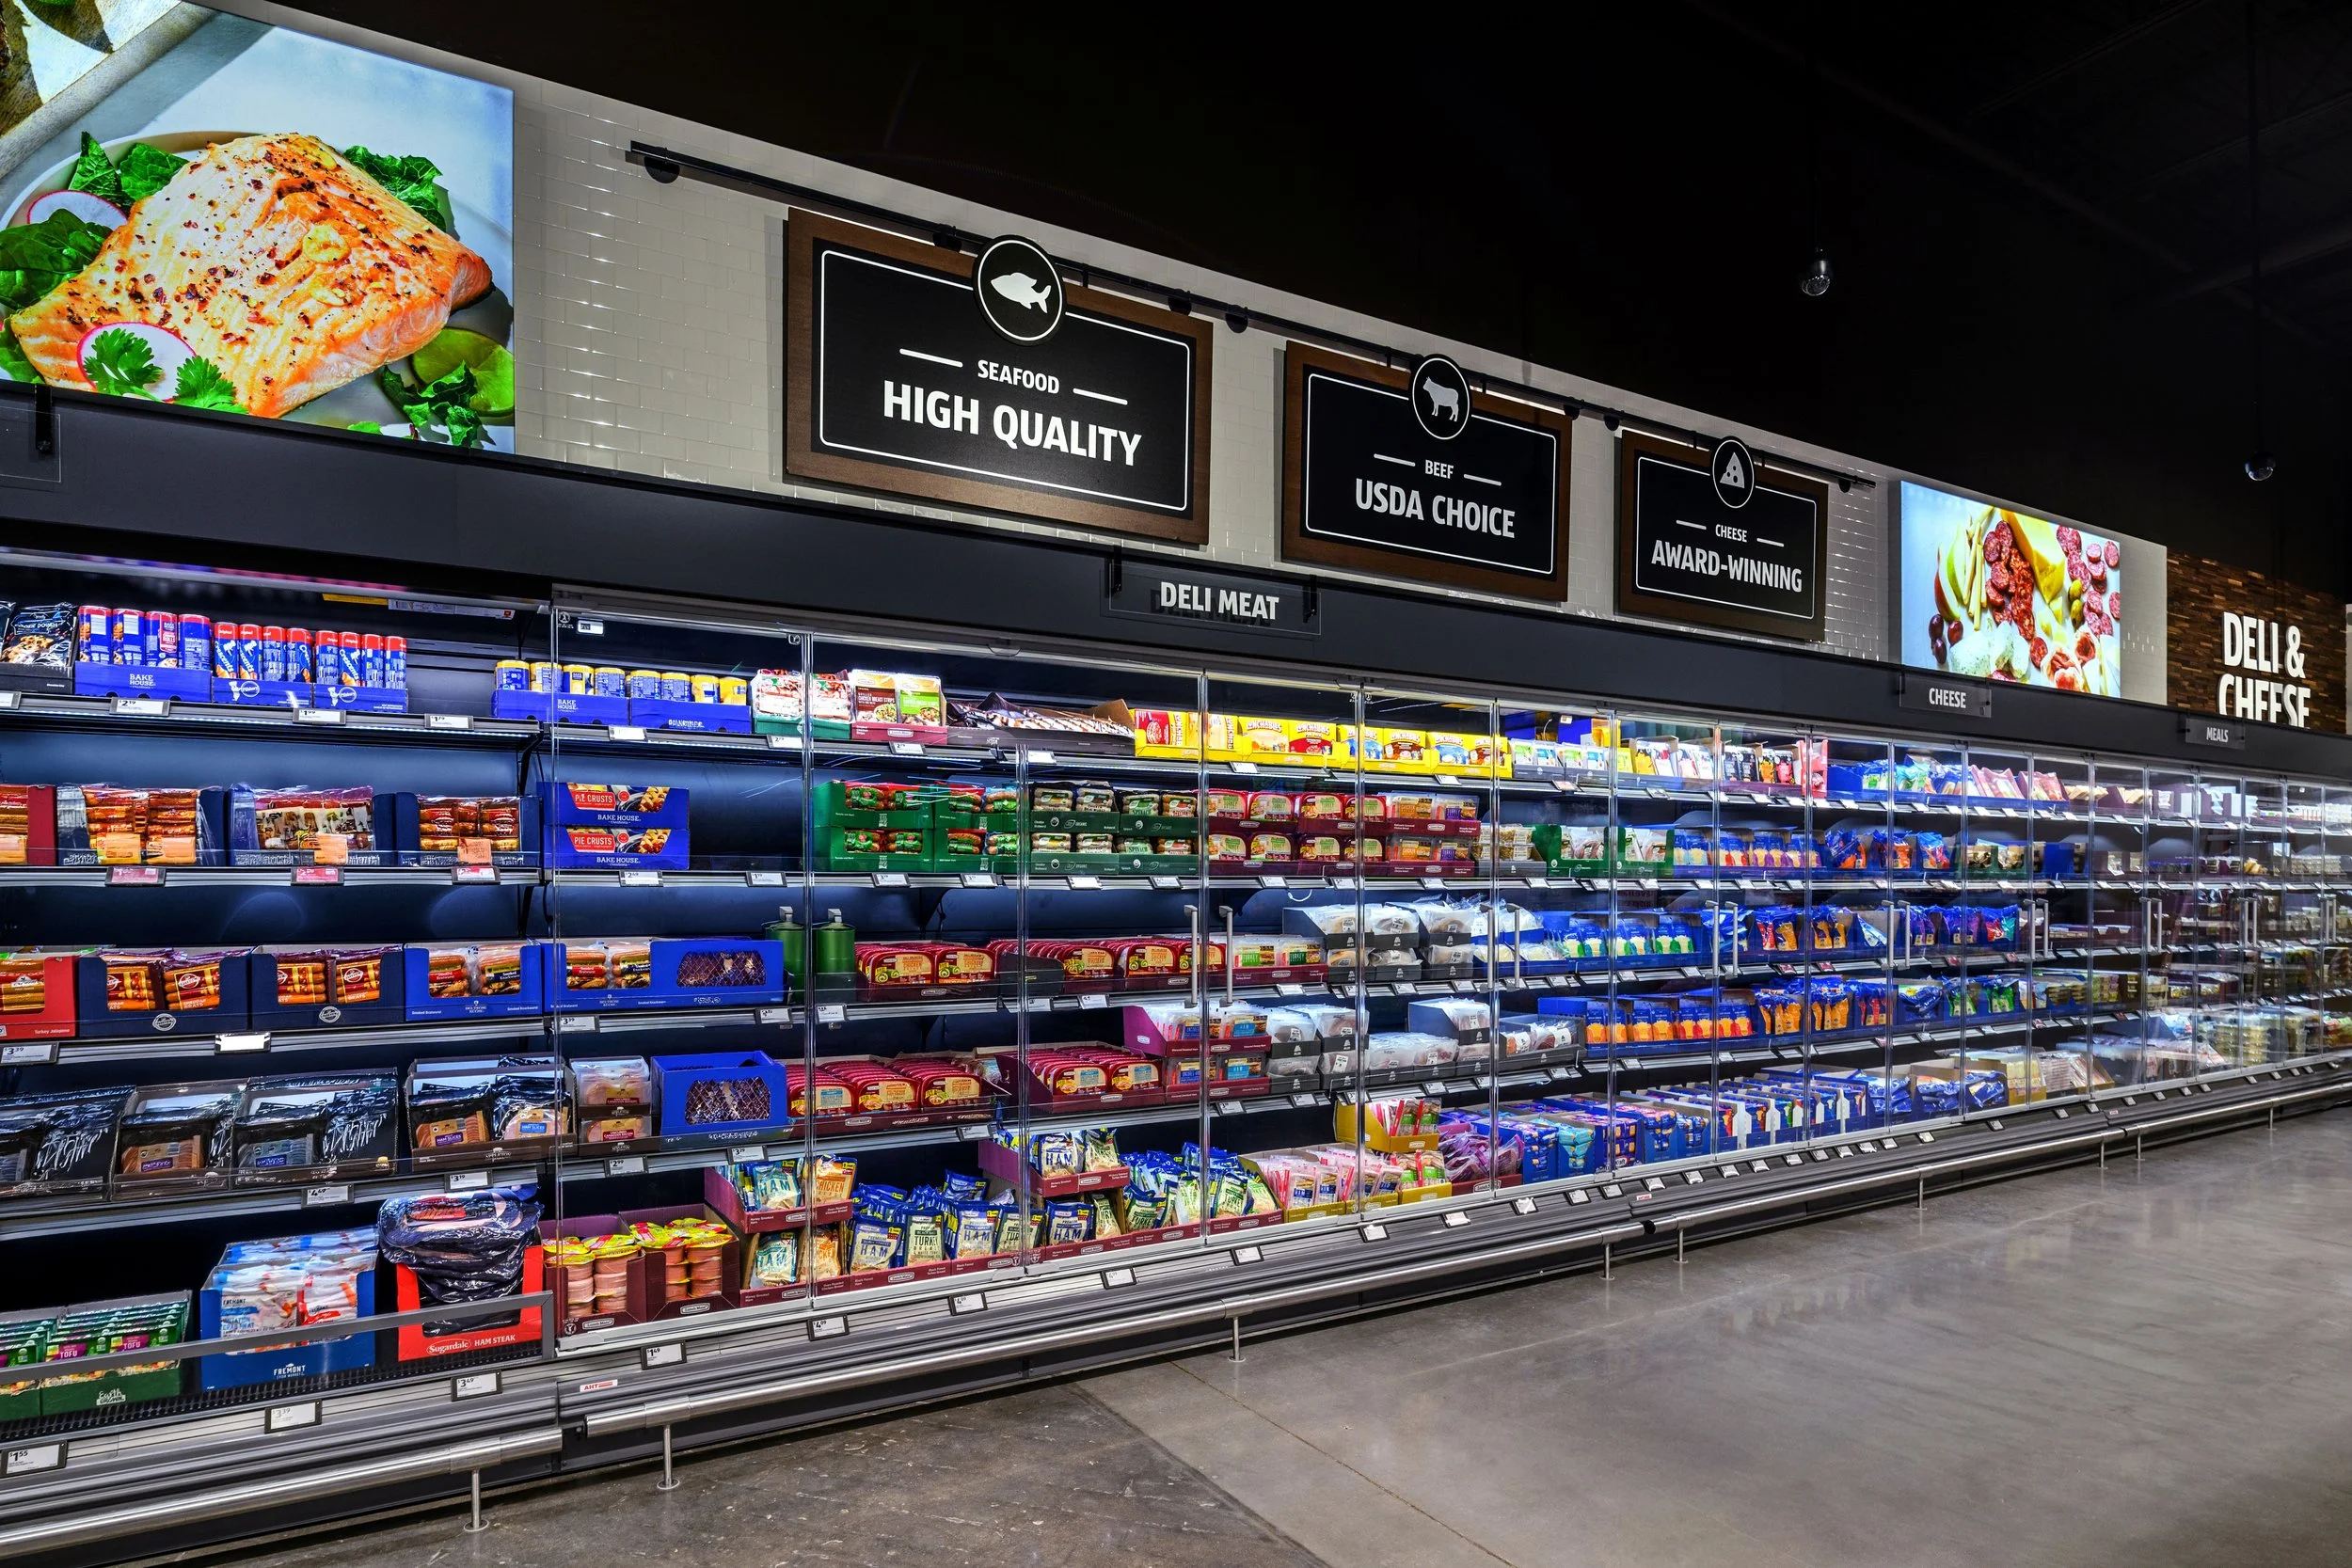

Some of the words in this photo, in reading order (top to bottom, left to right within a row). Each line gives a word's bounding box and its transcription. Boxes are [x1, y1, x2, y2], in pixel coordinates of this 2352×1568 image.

[977, 359, 1059, 394] SEAFOOD
[883, 380, 979, 435] HIGH
[993, 404, 1142, 467] QUALITY
[1424, 459, 1454, 480] BEEF
[1355, 478, 1424, 521] USDA
[1432, 495, 1516, 539] CHOICE
[1715, 523, 1748, 543] CHEESE
[1651, 540, 1803, 593] AWARD-WINNING
[1160, 581, 1211, 611] DELI
[1218, 589, 1279, 621] MEAT
[2223, 611, 2279, 673] DELI
[2284, 626, 2306, 678] &
[1929, 687, 1966, 708] CHEESE
[2218, 673, 2311, 729] CHEESE
[2206, 727, 2229, 743] MEALS
[587, 795, 612, 803] CRUSTS
[1046, 1152, 1072, 1165] HAM
[759, 1180, 791, 1197] HAM
[816, 1180, 844, 1193] CHICKEN
[964, 1230, 989, 1242] HAM
[1055, 1229, 1081, 1241] HAM
[860, 1245, 888, 1257] HAM
[124, 1341, 141, 1350] TOFU
[429, 1340, 469, 1354] Sugardale
[474, 1338, 491, 1346] HAM
[493, 1334, 516, 1344] STEAK
[60, 1350, 77, 1359] TOFU
[274, 1365, 306, 1376] FREMONT
[98, 1388, 122, 1399] Earth
